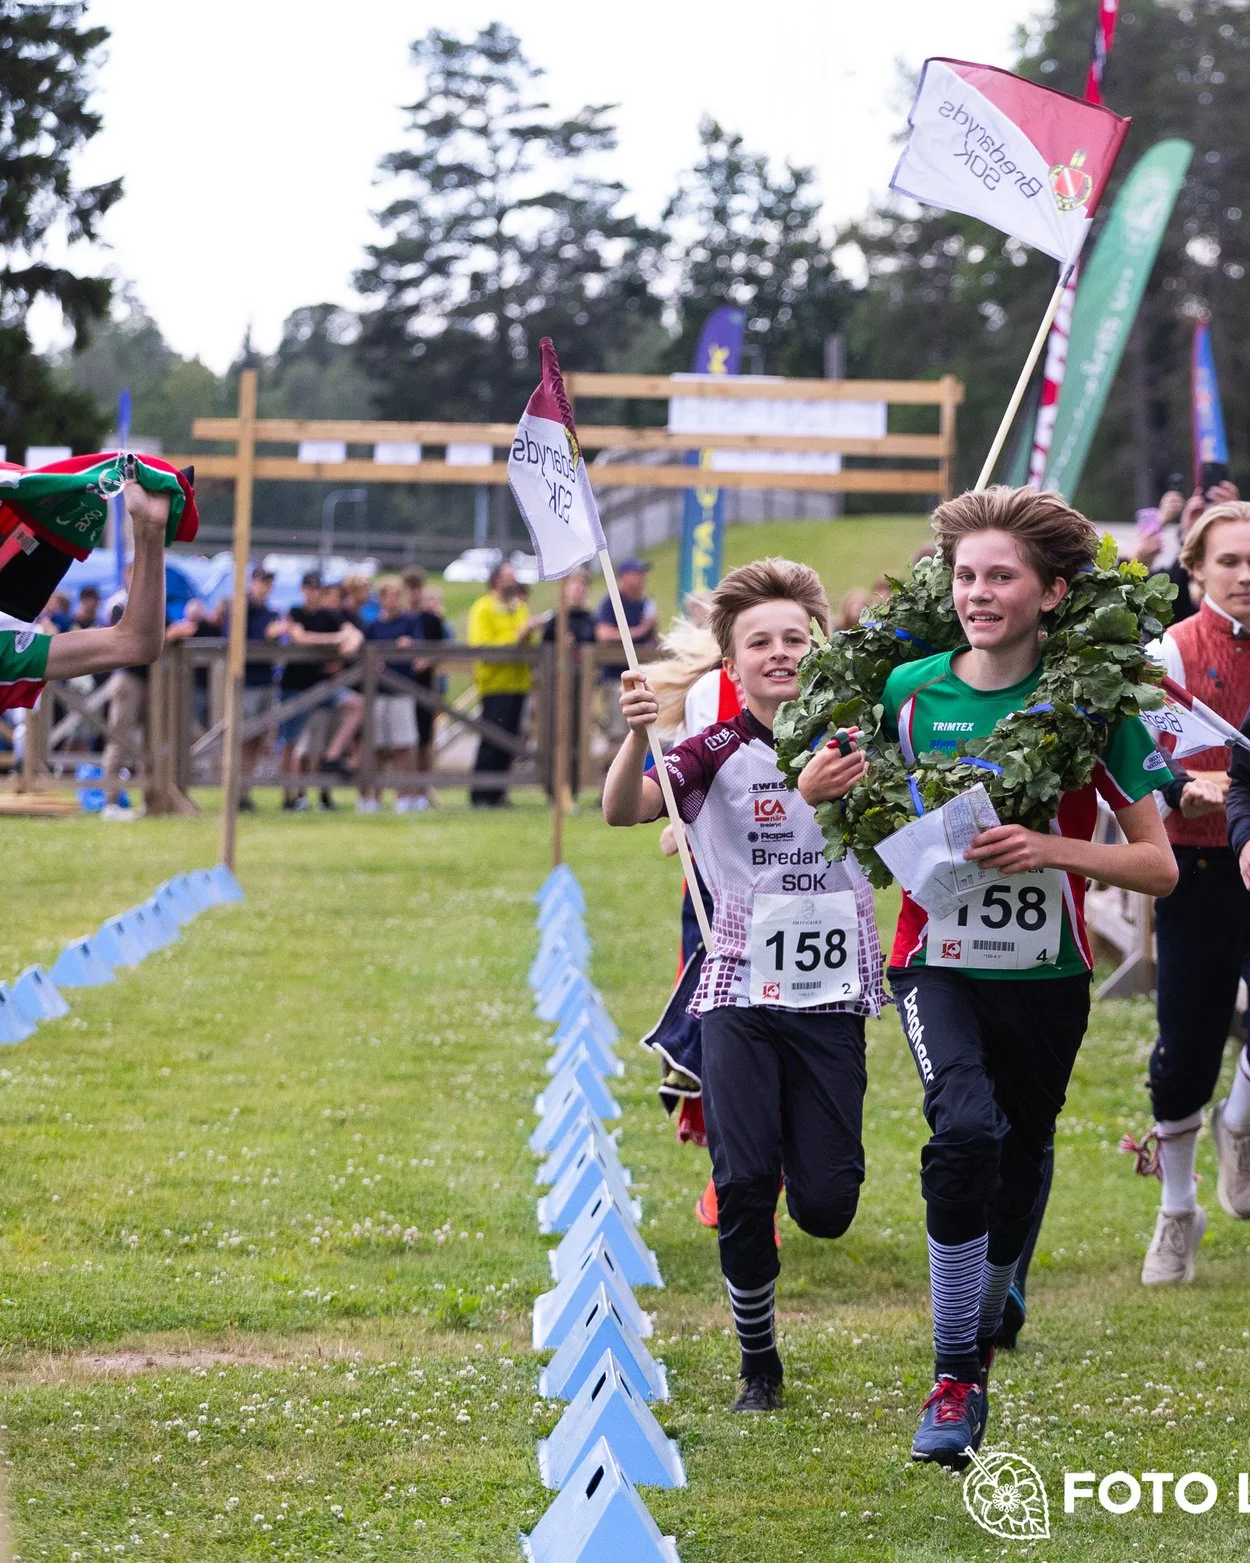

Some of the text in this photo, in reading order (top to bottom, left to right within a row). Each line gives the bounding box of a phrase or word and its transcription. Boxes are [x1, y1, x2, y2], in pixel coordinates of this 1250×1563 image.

[933, 721, 975, 731] TRIMTEX
[752, 781, 786, 791] EWES
[754, 799, 786, 816] ICA
[752, 848, 848, 869] Bredar
[782, 873, 827, 892] SOK
[765, 928, 848, 972] 158
[1036, 948, 1048, 962] 4
[841, 982, 853, 995] 2
